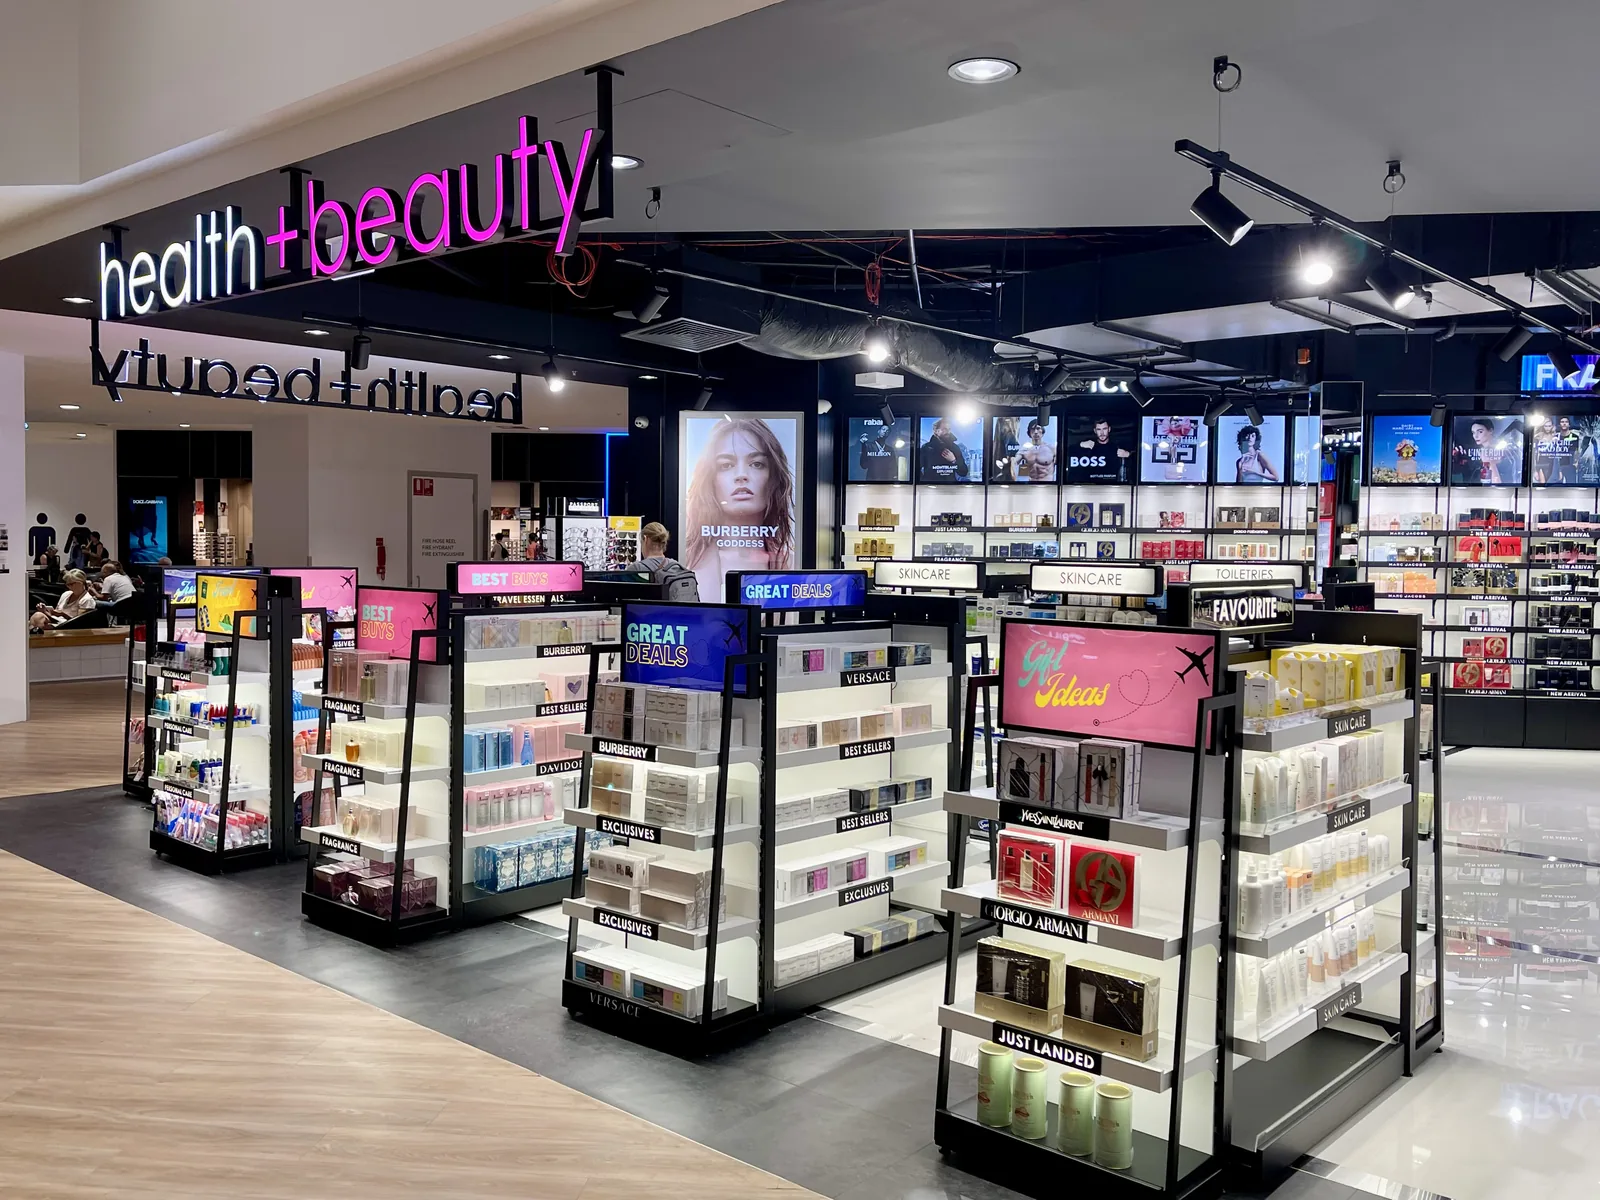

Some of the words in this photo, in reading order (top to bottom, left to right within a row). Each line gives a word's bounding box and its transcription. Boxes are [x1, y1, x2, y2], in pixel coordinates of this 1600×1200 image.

[1070, 456, 1107, 468] BOSS
[701, 525, 779, 538] BURBERRY
[716, 539, 764, 548] GODDESS
[471, 572, 509, 587] BEST
[511, 572, 549, 586] BUYS
[899, 568, 951, 581] SKINCARE
[1060, 572, 1122, 587] SKINCARE
[1215, 568, 1273, 581] TOILETRIES
[492, 596, 521, 604] TRAVEL
[745, 584, 789, 599] GREAT
[791, 583, 833, 598] DEALS
[362, 604, 394, 622] BEST
[1213, 597, 1277, 622] FAVOURITE
[360, 620, 395, 641] BUYS
[626, 623, 688, 645] GREAT
[543, 645, 587, 656] BURBERRY
[626, 642, 688, 668] DEALS
[846, 670, 891, 685] VERSACE
[1035, 672, 1110, 708] Ideas
[324, 699, 360, 714] FRAGRANCE
[541, 705, 558, 715] BEST
[1334, 719, 1349, 734] SKIN
[1350, 714, 1366, 730] CARE
[599, 740, 649, 759] BURBERRY
[844, 744, 862, 757] BEST
[862, 740, 892, 754] SELLERS
[324, 761, 360, 778] FRAGRANCE
[841, 817, 859, 830] BEST
[860, 811, 889, 825] SELLERS
[1333, 812, 1348, 828] SKIN
[1348, 805, 1365, 822] CARE
[602, 819, 655, 840] EXCLUSIVES
[321, 835, 358, 854] FRAGRANCE
[844, 881, 890, 903] EXCLUSIVES
[599, 912, 652, 937] EXCLUSIVES
[985, 903, 1033, 927] GIORGIO
[1035, 916, 1084, 940] ARMANI
[1081, 909, 1119, 925] ARMANI
[589, 991, 641, 1018] VERSACE
[1324, 1003, 1339, 1022] SKIN
[1339, 991, 1356, 1012] CARE
[998, 1028, 1031, 1051] JUST
[1033, 1039, 1095, 1070] LANDED
